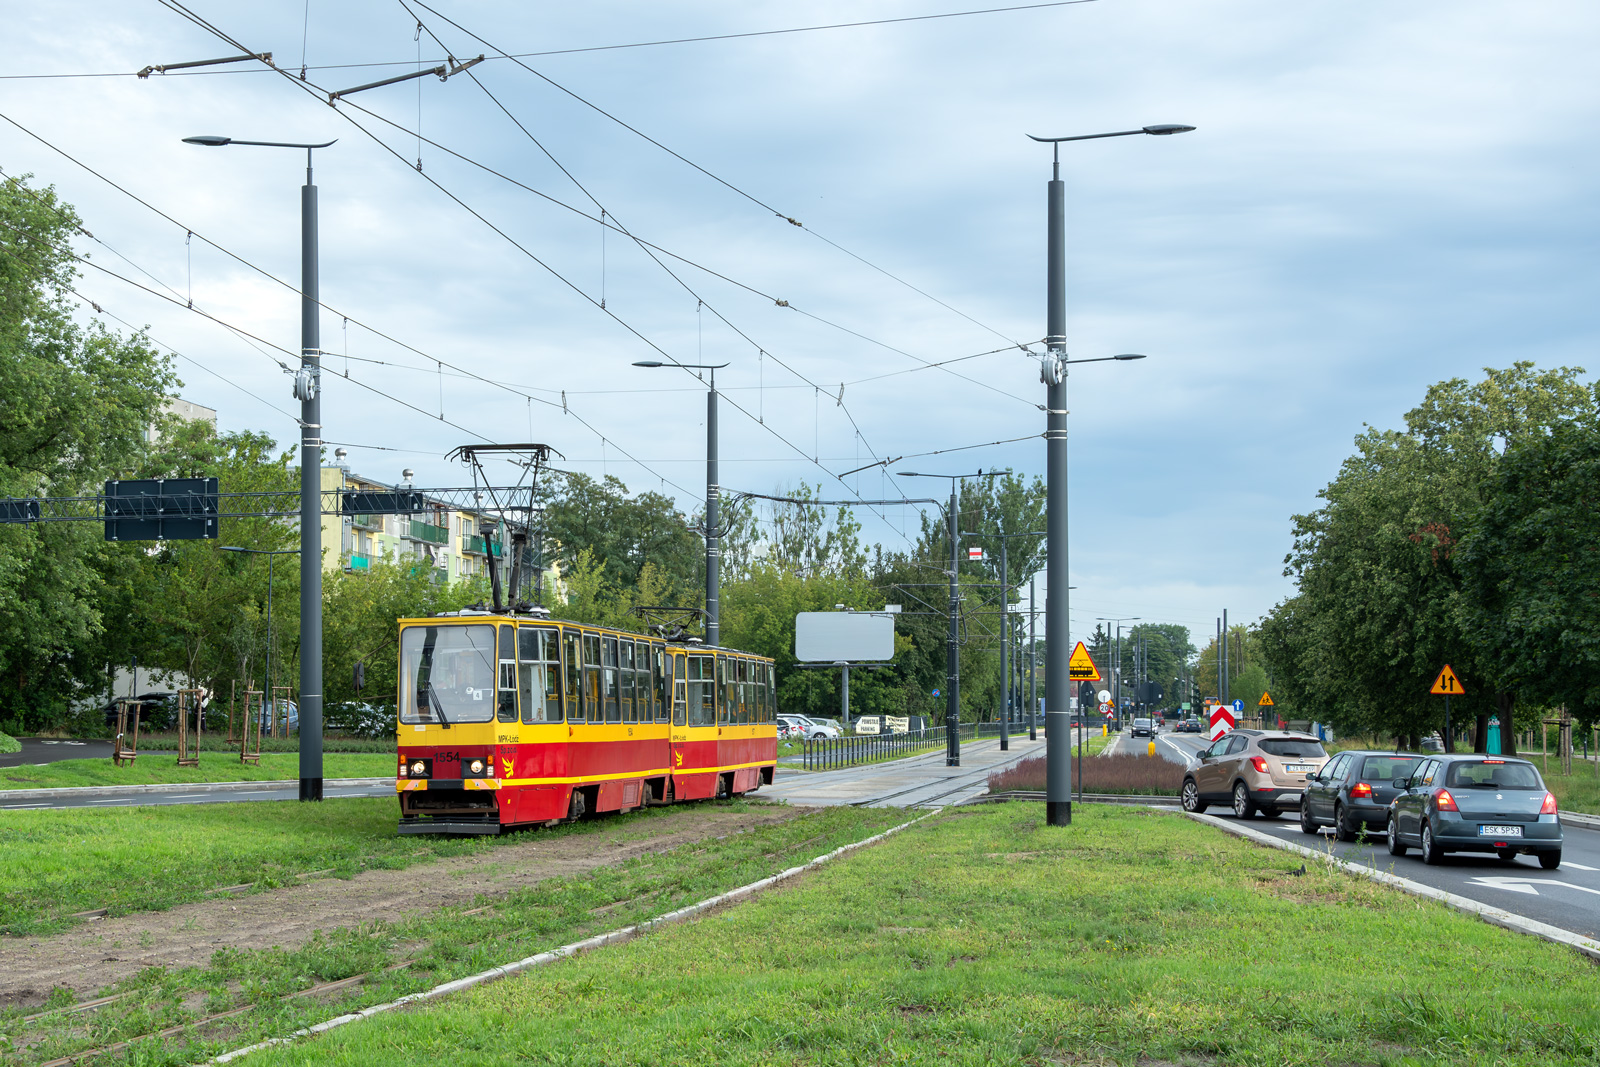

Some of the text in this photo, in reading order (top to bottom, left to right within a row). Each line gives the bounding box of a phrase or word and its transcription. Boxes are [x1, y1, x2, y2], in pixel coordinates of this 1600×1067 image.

[433, 751, 460, 763] 1554
[1484, 826, 1520, 835] ESK 5P53
